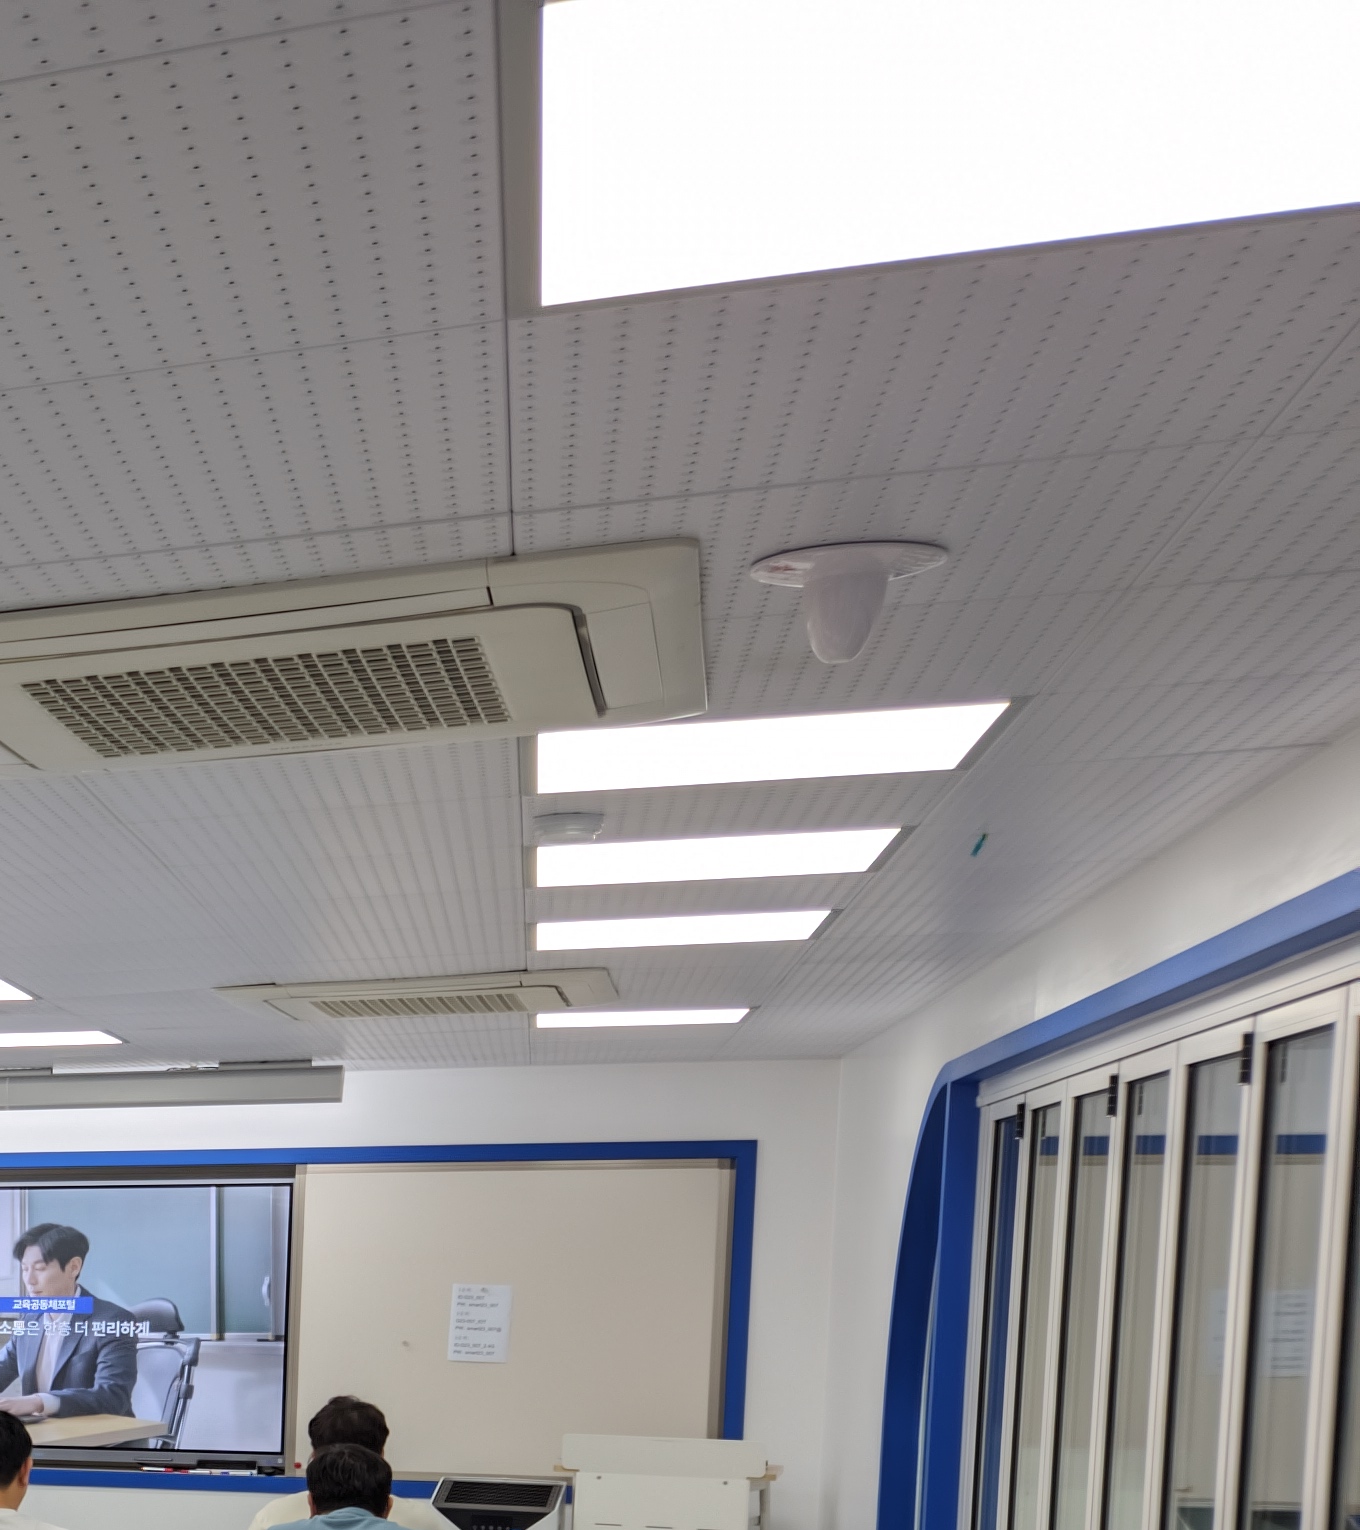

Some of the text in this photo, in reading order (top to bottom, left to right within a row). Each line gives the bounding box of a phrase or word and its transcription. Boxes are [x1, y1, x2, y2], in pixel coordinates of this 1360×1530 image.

[12, 1299, 76, 1311] 교육공동체포털
[43, 1321, 72, 1336] 한층
[74, 1320, 88, 1337] 더
[92, 1320, 150, 1337] 편리하게
